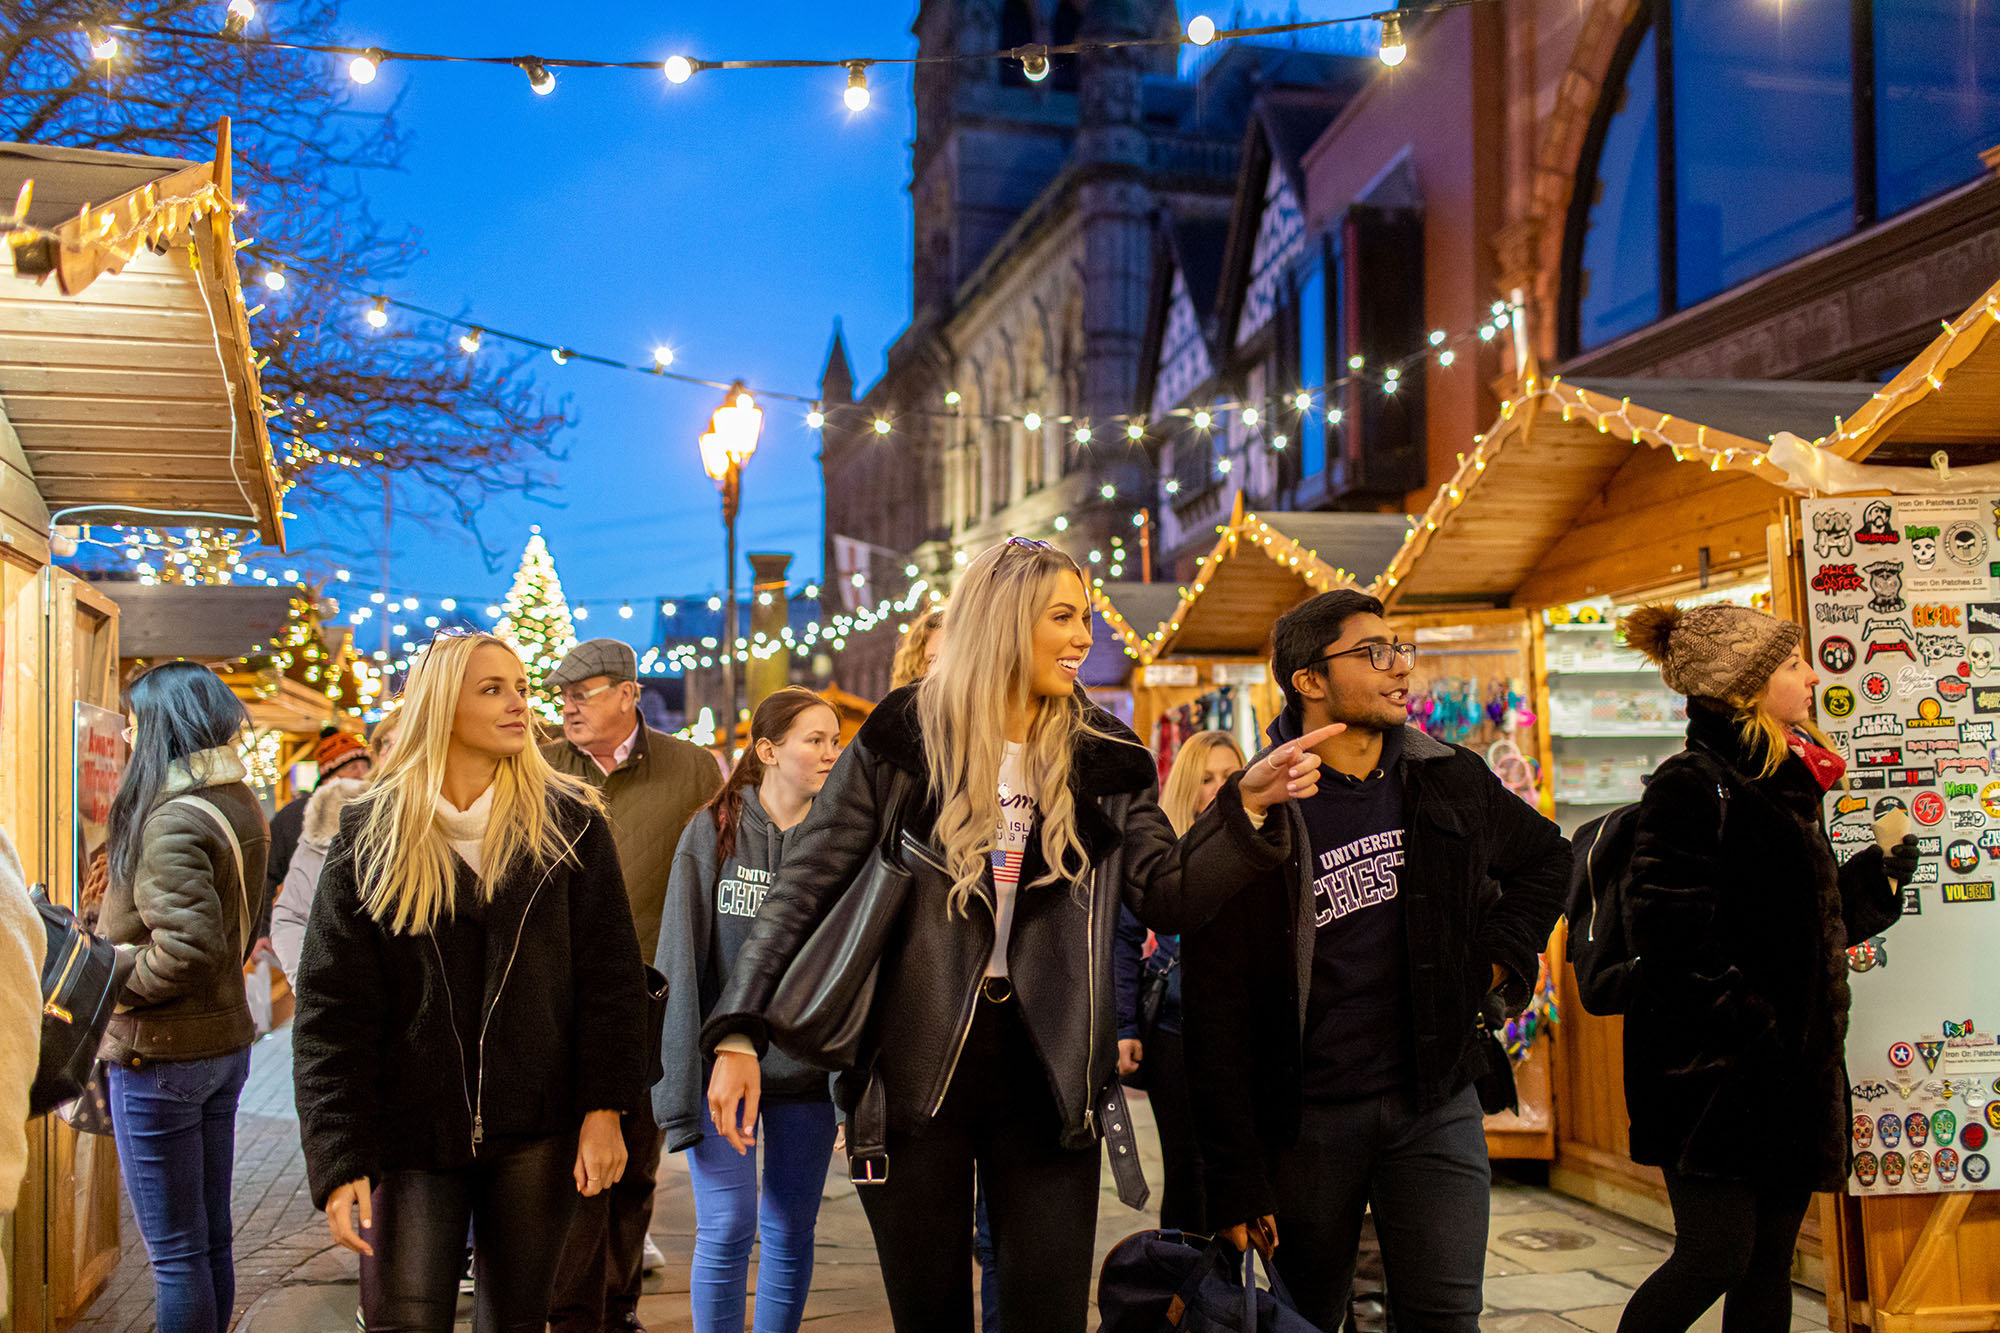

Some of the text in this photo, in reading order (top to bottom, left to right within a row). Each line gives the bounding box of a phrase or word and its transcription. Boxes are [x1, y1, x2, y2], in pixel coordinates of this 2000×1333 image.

[1926, 498, 1954, 506] Patches
[1941, 578, 1970, 586] Patches
[1862, 715, 1895, 726] BLACK
[1908, 718, 1954, 728] OFFSPRING
[1855, 725, 1902, 737] SABBATH
[1962, 731, 1993, 742] PARK
[1319, 829, 1405, 870] UNIVERSIT
[1951, 844, 1975, 860] PUNK
[1945, 883, 1993, 901] VOLBEAT
[1852, 1086, 1887, 1101] BATMAN
